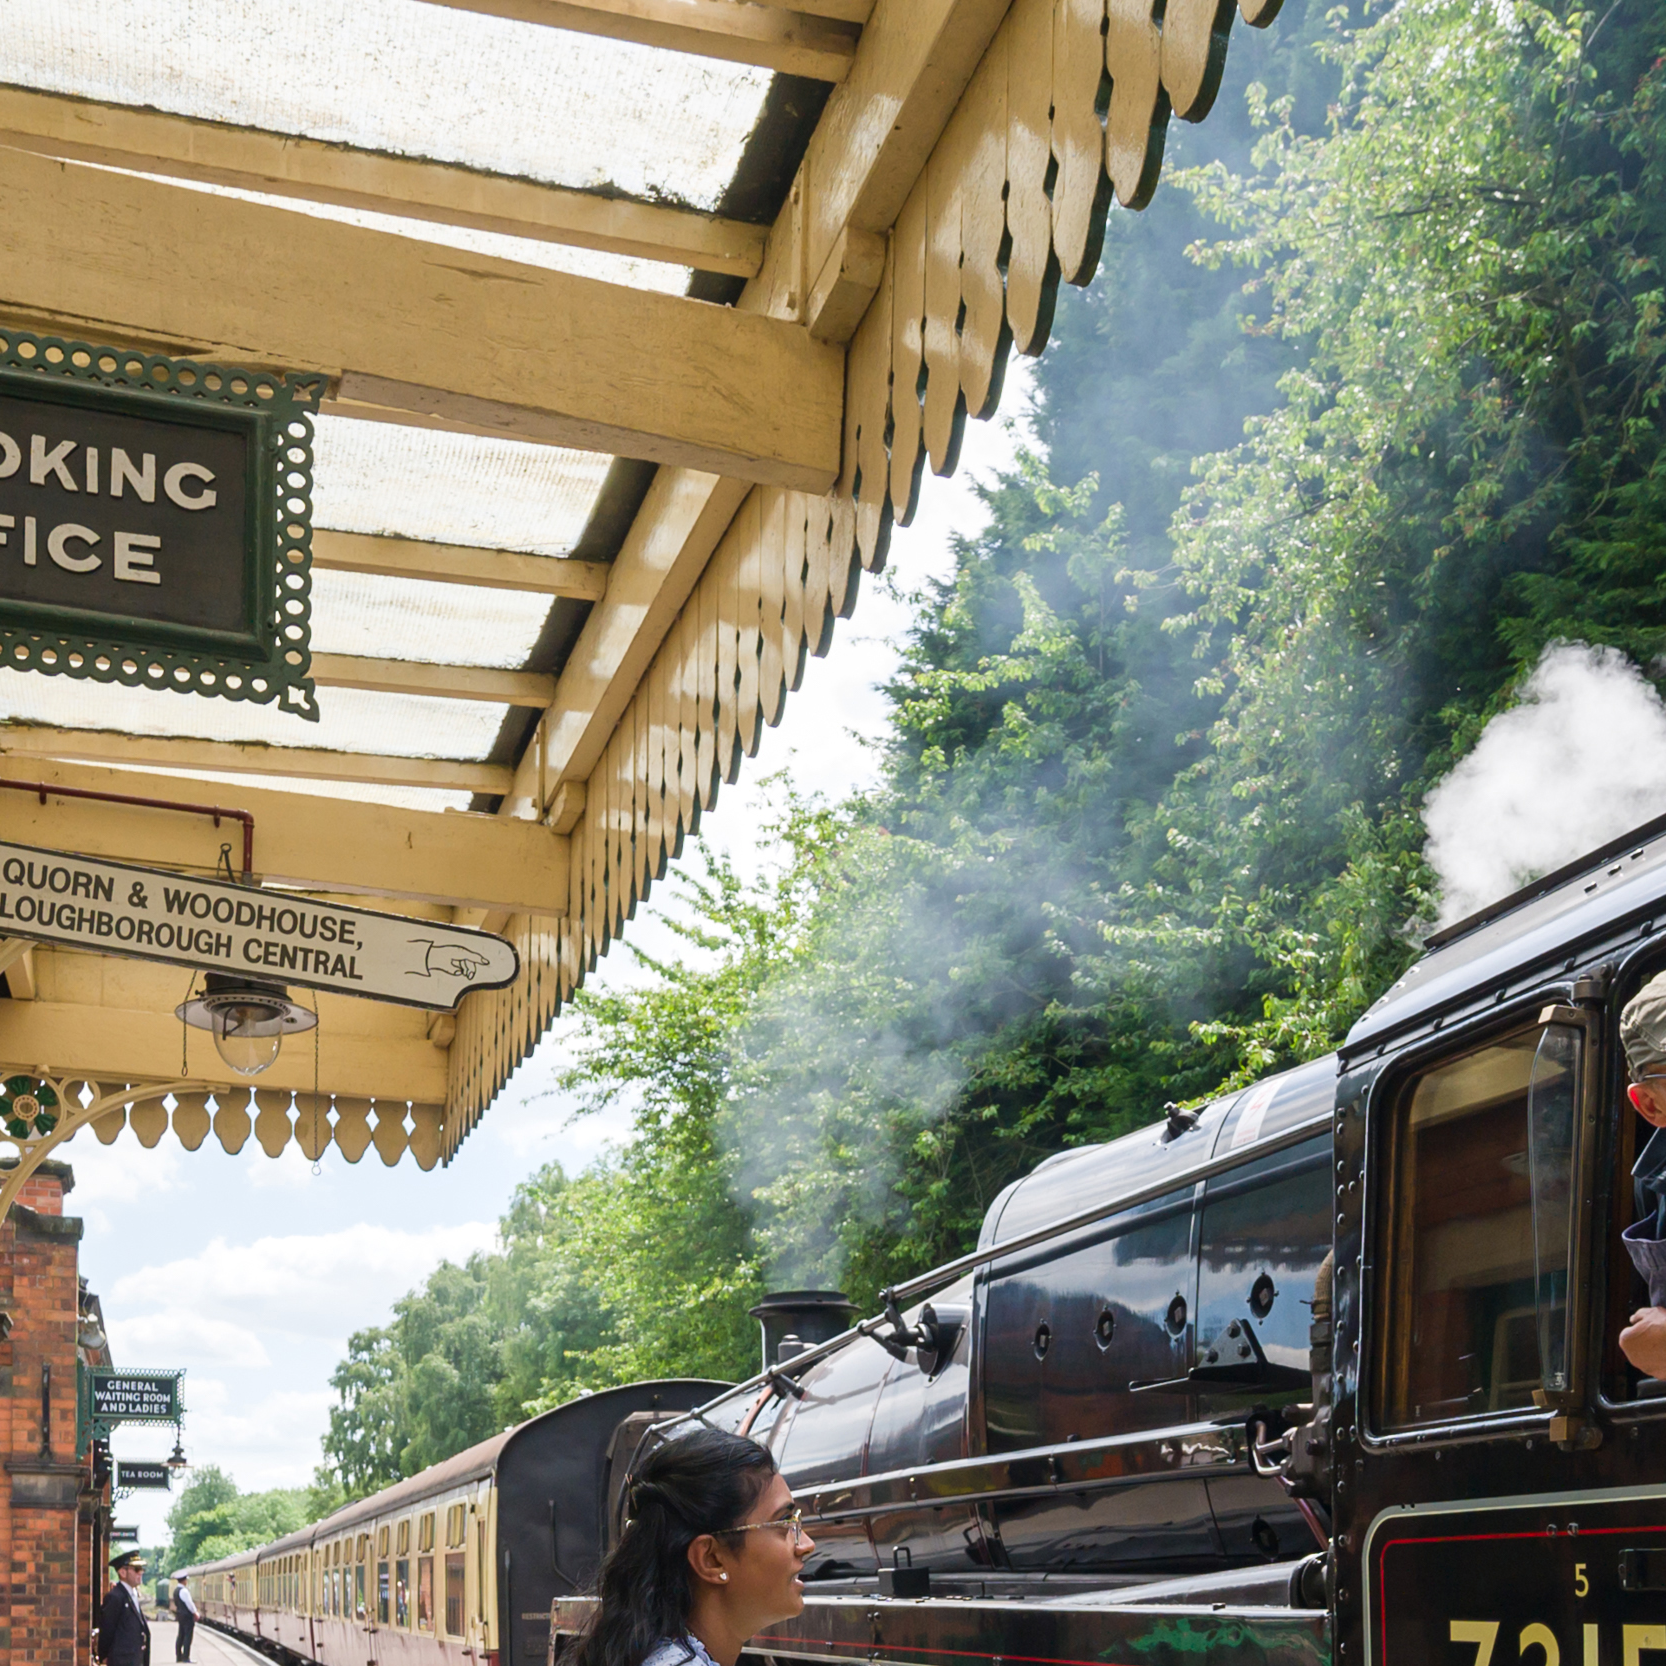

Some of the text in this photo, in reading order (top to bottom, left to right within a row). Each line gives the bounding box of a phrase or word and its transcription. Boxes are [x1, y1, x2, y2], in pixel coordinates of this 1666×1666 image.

[1, 857, 114, 903] QUORN
[129, 880, 150, 909] &
[162, 885, 364, 951] WOODHOUSE,
[242, 936, 363, 981] CENTRAL
[107, 1380, 159, 1392] GENERAL
[95, 1391, 171, 1403] WAITING ROOM
[101, 1402, 167, 1414] AND LADIES
[121, 1470, 163, 1478] TEA ROOM
[1574, 1563, 1589, 1598] 5
